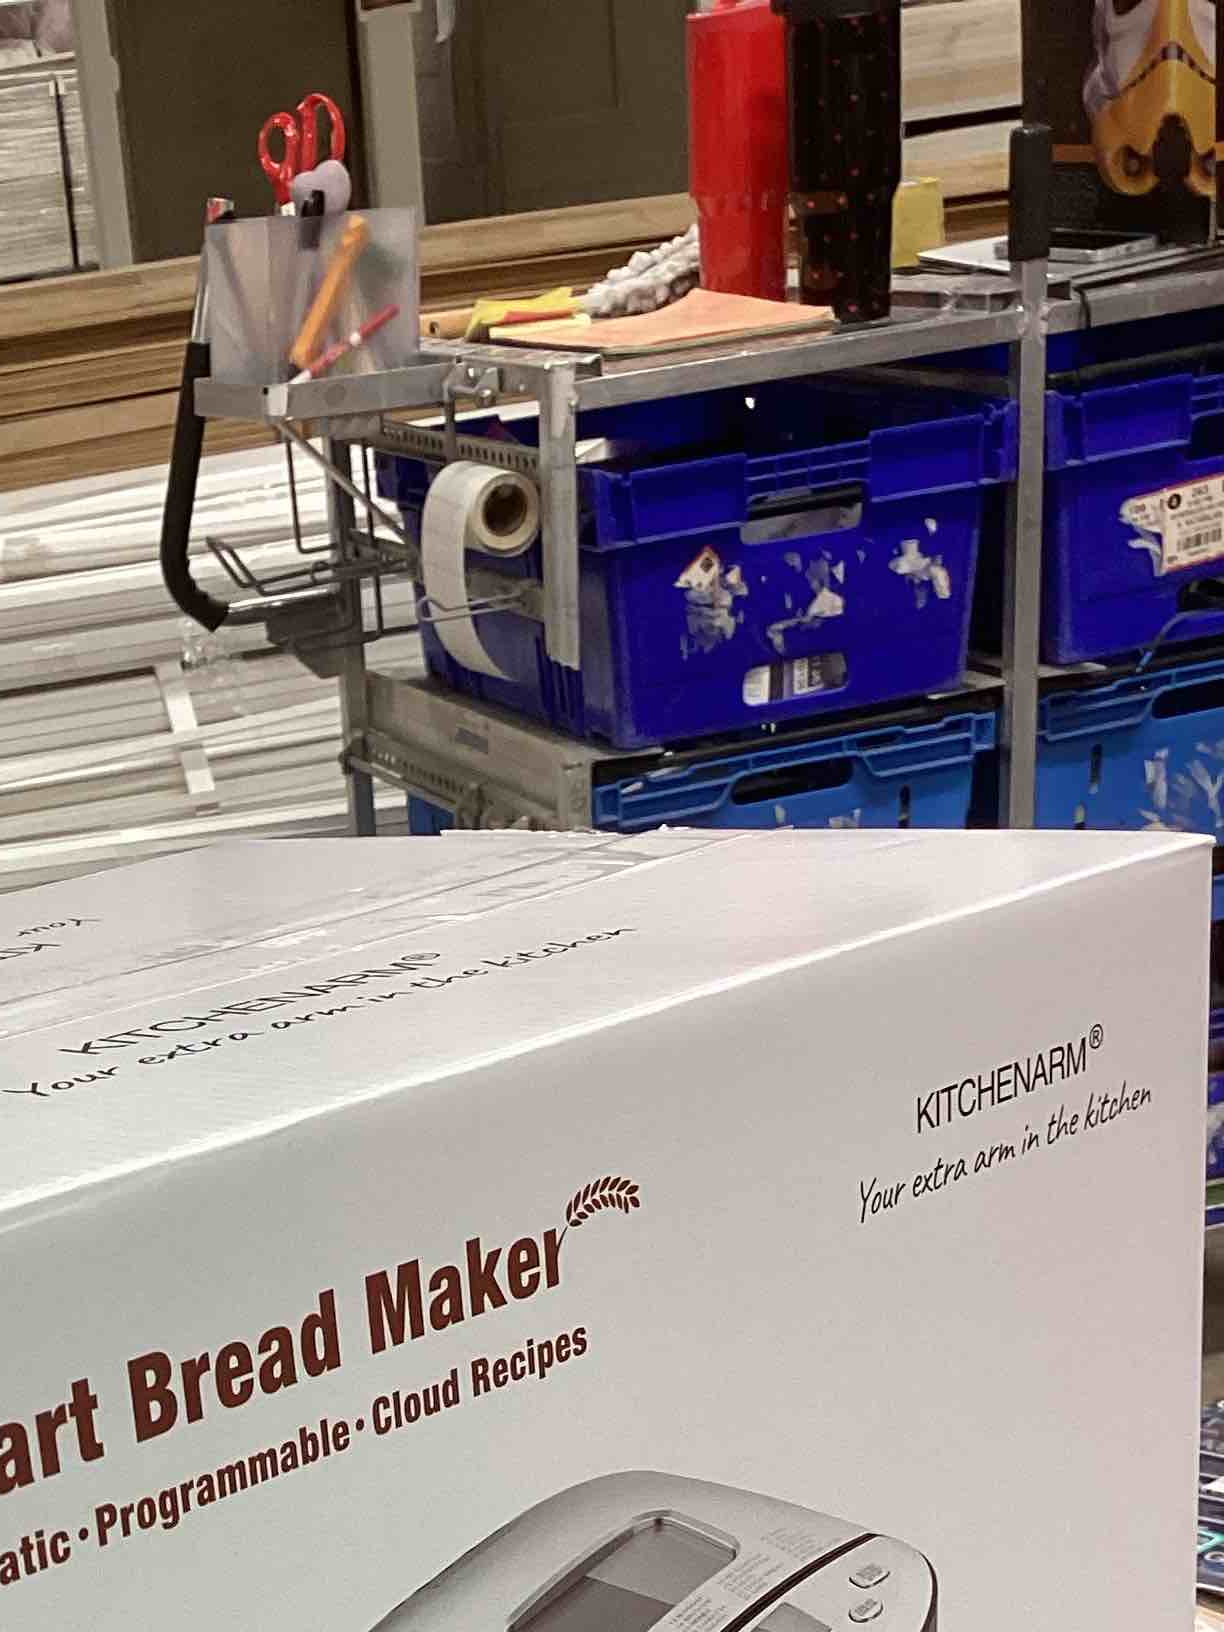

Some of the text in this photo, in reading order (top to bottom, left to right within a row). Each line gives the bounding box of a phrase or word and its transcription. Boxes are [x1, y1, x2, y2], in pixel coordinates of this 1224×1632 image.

[4, 1065, 120, 1099] Your
[137, 1031, 262, 1065] extra
[271, 1005, 360, 1030] arm
[409, 967, 491, 992] the
[489, 925, 637, 971] kitchen
[16, 916, 101, 937] Your
[859, 1080, 1152, 1225] Your extra arm in the kitchen
[127, 1289, 342, 1444] Bread
[366, 1227, 566, 1356] Maker
[95, 1417, 352, 1549] Programmable
[372, 1378, 461, 1437] Cloud
[471, 1326, 589, 1398] Recipes
